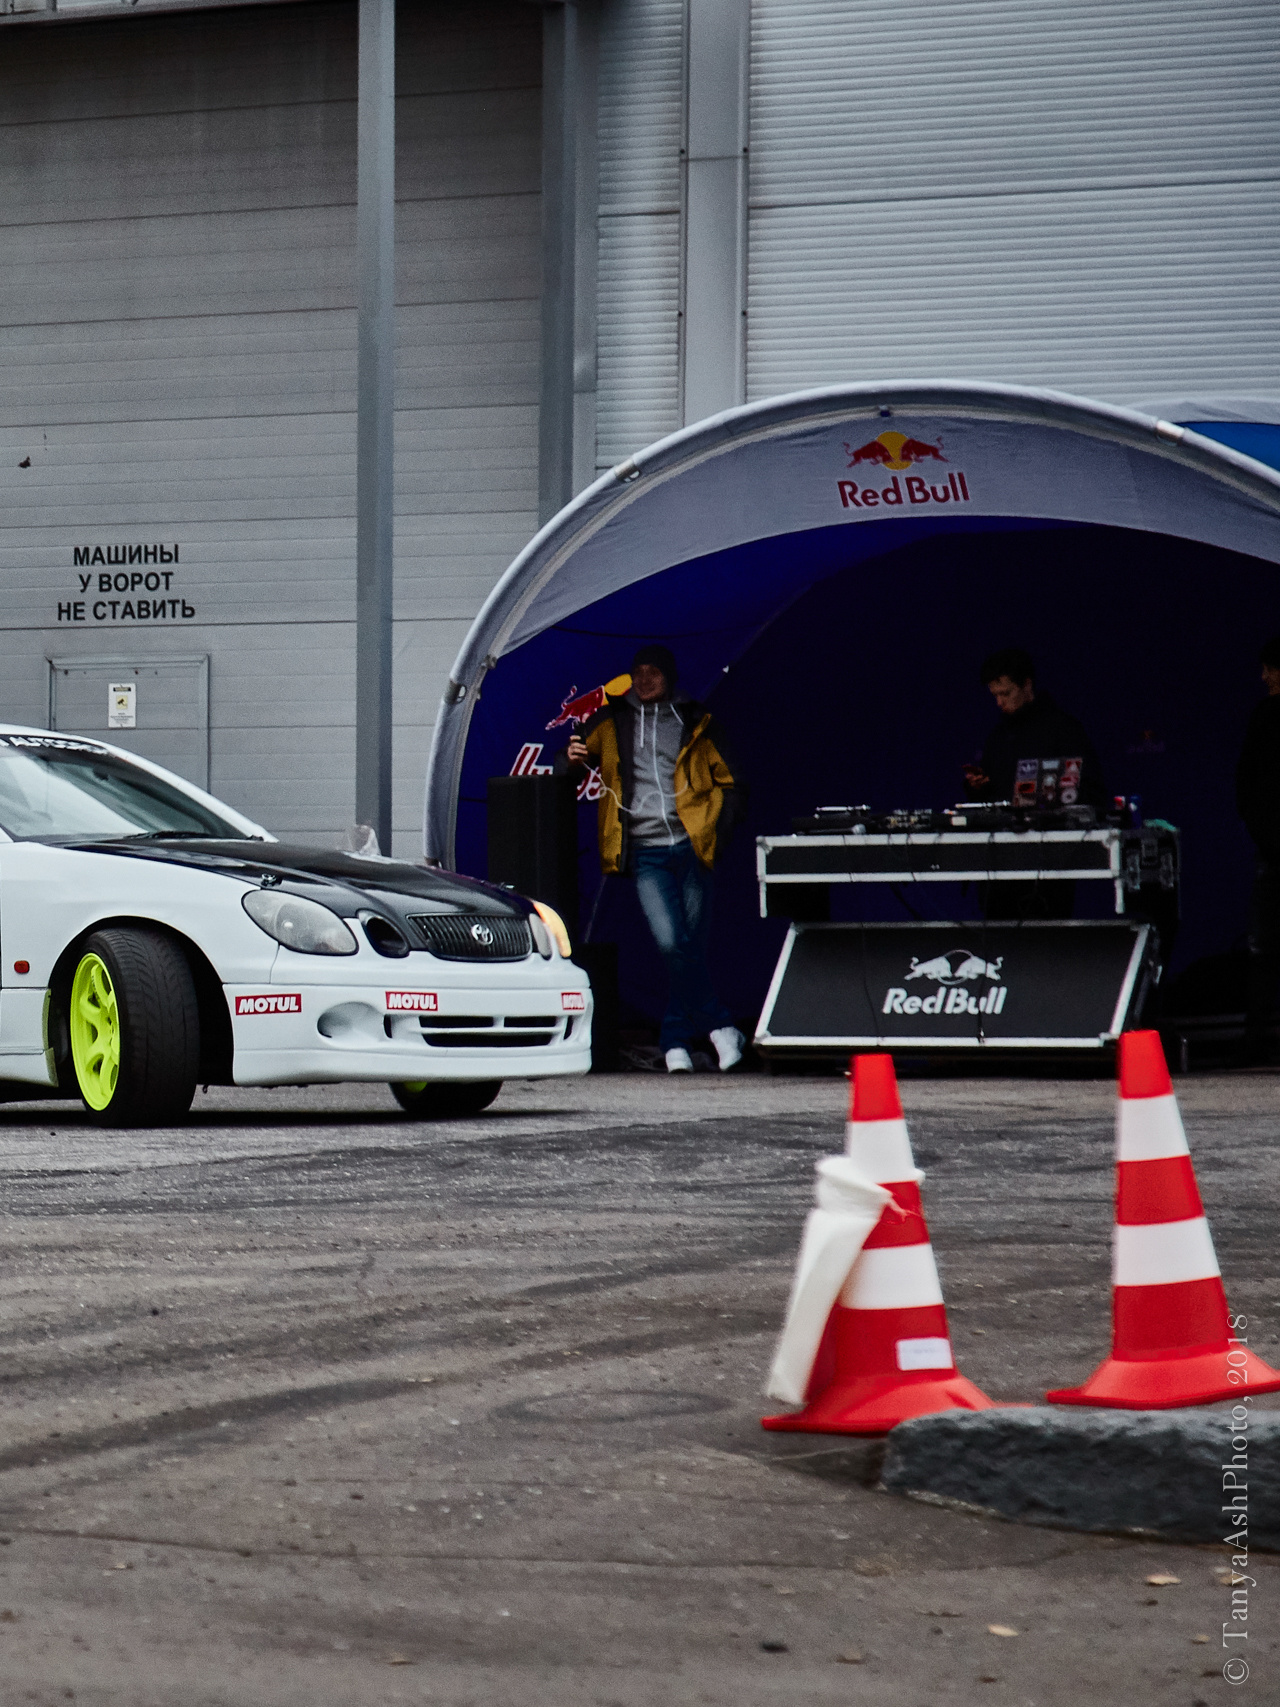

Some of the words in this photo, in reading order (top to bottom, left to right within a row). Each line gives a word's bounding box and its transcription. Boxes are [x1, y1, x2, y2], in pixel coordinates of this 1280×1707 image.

[837, 475, 903, 508] Red
[905, 472, 970, 504] Bull
[73, 544, 179, 566] МАШИНЫ
[78, 574, 91, 593] У
[98, 571, 173, 592] ВОРОТ
[57, 602, 86, 621] НЕ
[92, 599, 196, 621] СТАВИТЬ
[238, 995, 299, 1013] MOTUL
[387, 992, 437, 1010] MOTUL
[882, 986, 947, 1014] Red
[944, 986, 1007, 1014] Bull
